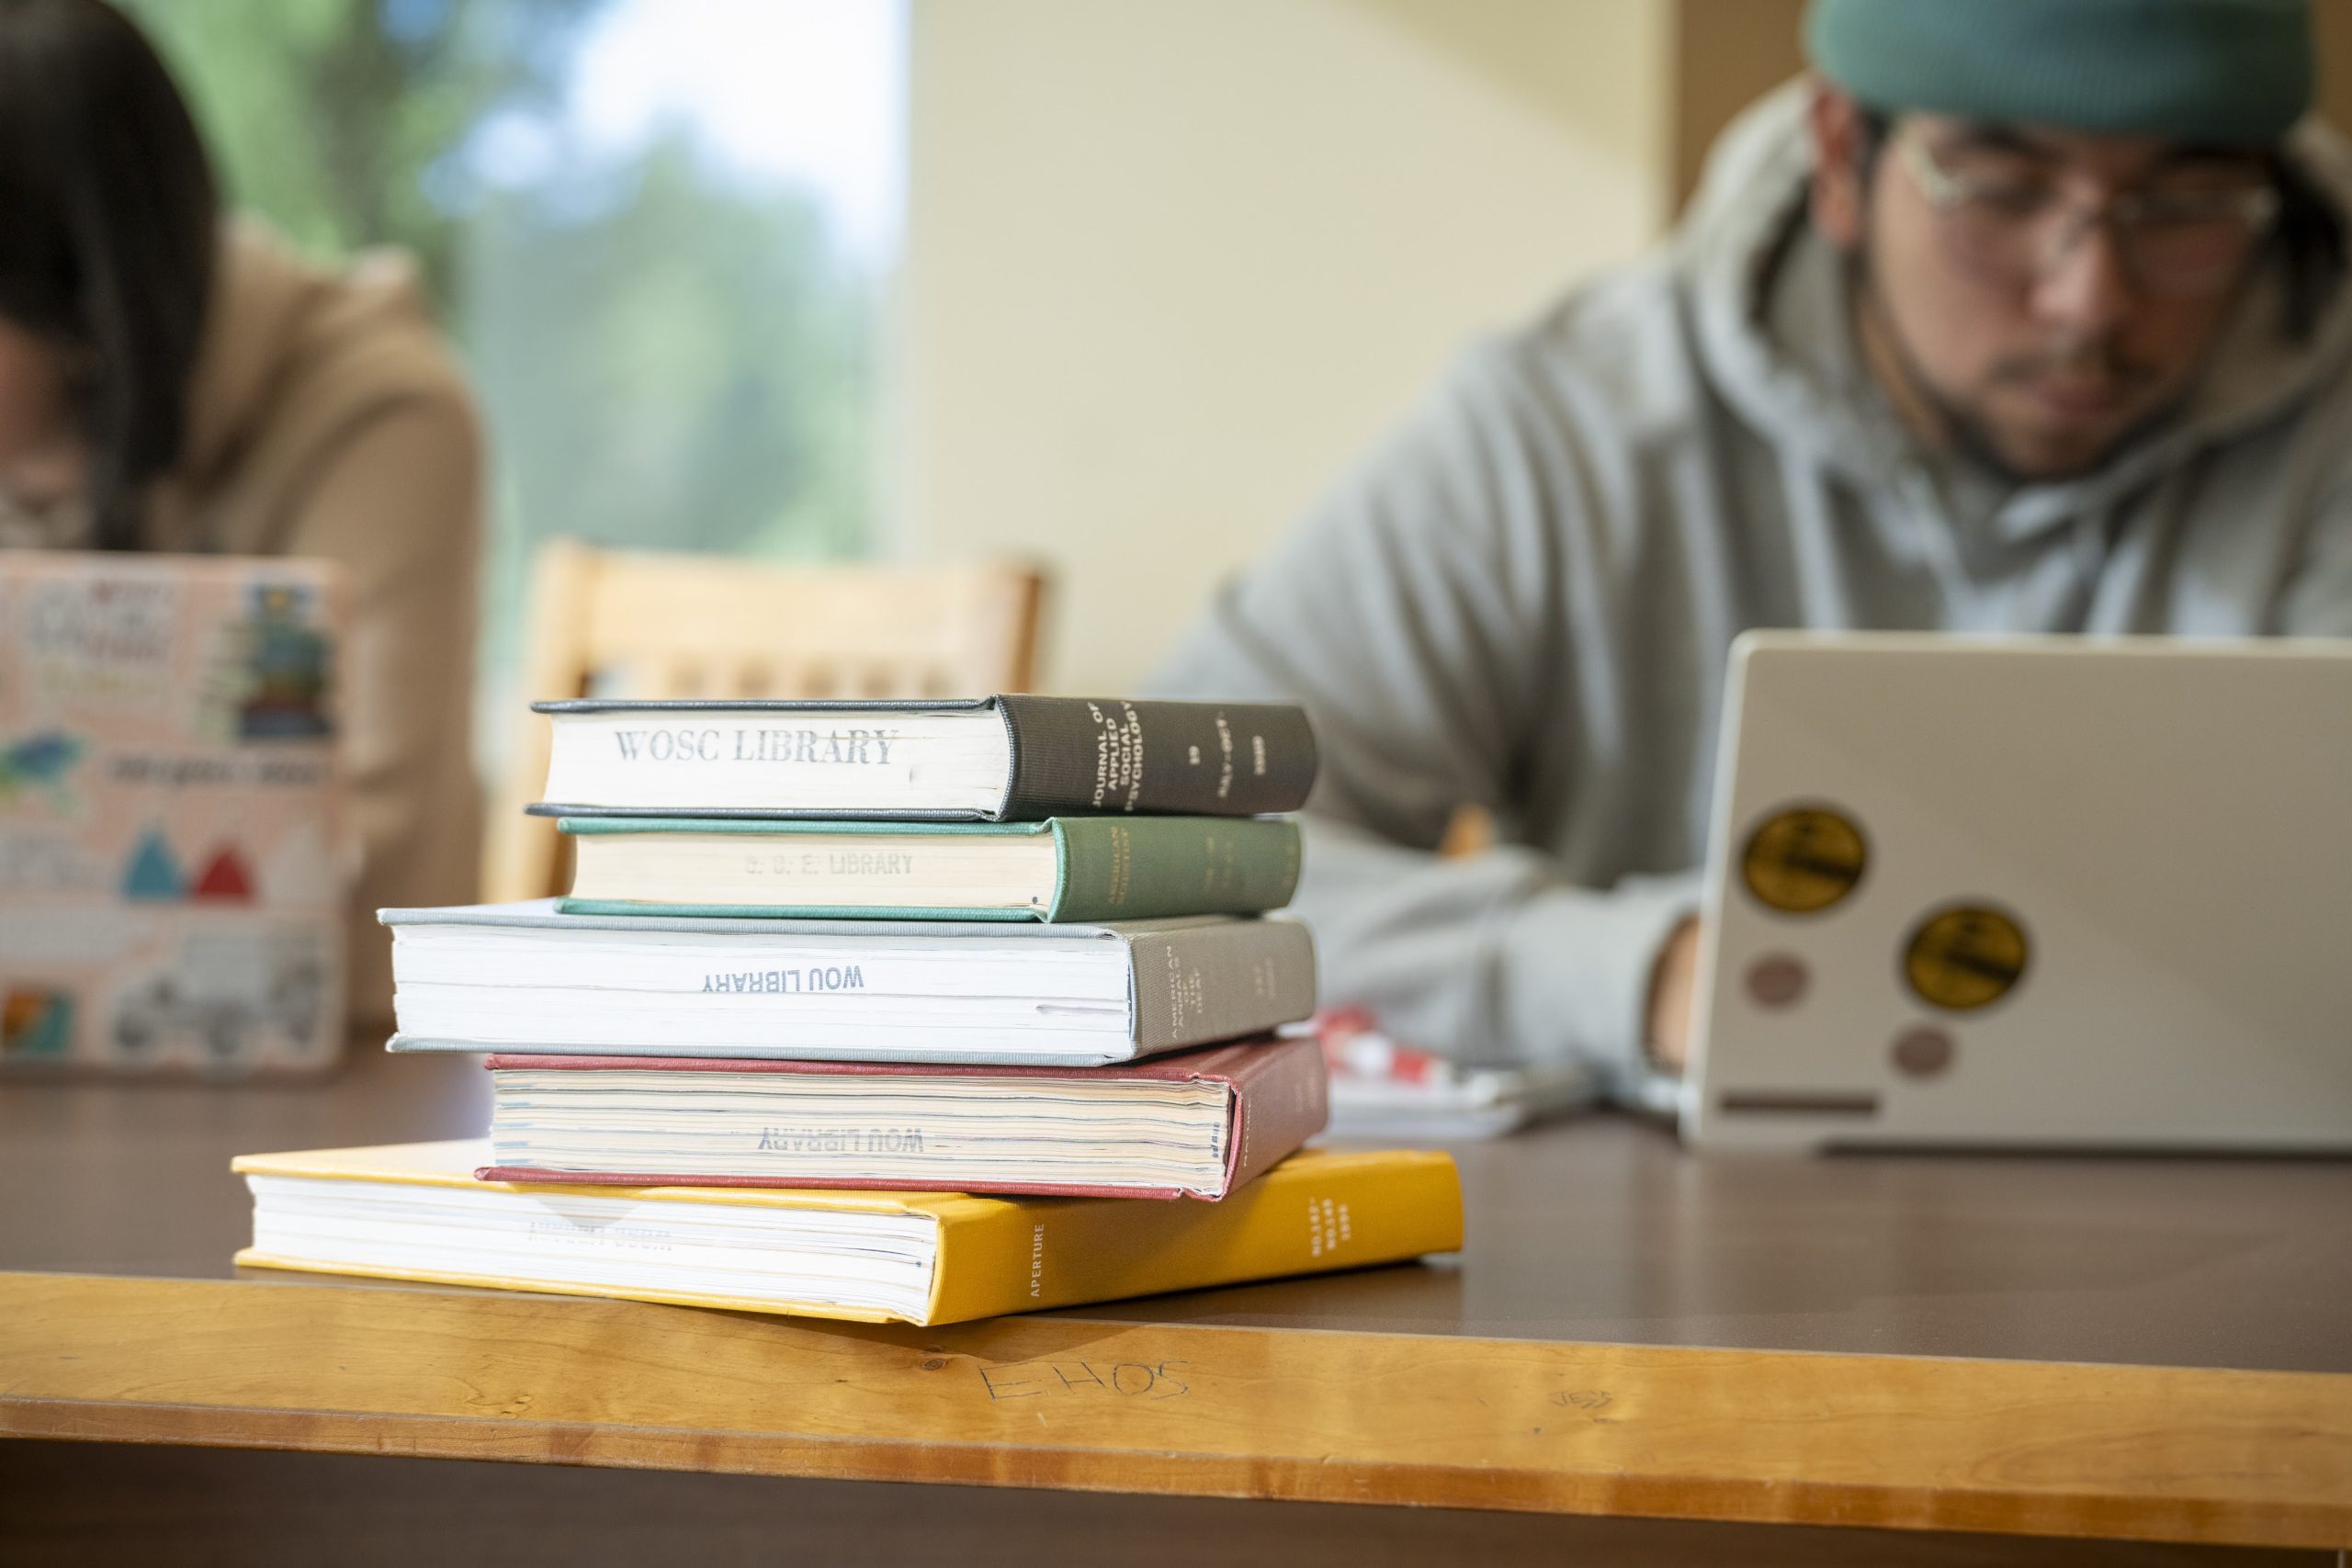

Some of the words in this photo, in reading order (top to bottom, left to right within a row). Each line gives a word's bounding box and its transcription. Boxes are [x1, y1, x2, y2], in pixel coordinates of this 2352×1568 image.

[1087, 701, 1103, 724] OF
[615, 729, 719, 761] WOSC
[731, 728, 899, 765] LIBRARY
[1092, 730, 1108, 807] JOURNAL
[1106, 717, 1120, 791] APPLIED
[1119, 723, 1132, 786] SOCIAL
[1120, 701, 1144, 812] PSYCHOLOGY
[828, 853, 912, 874] LIBRARY
[702, 969, 800, 993] LIBRARY
[808, 965, 865, 991] WOU
[1166, 945, 1177, 1039] AMERICAN
[1174, 957, 1183, 1027] ANNALS
[867, 1128, 924, 1152] WOU
[1030, 1223, 1045, 1298] APERTURE
